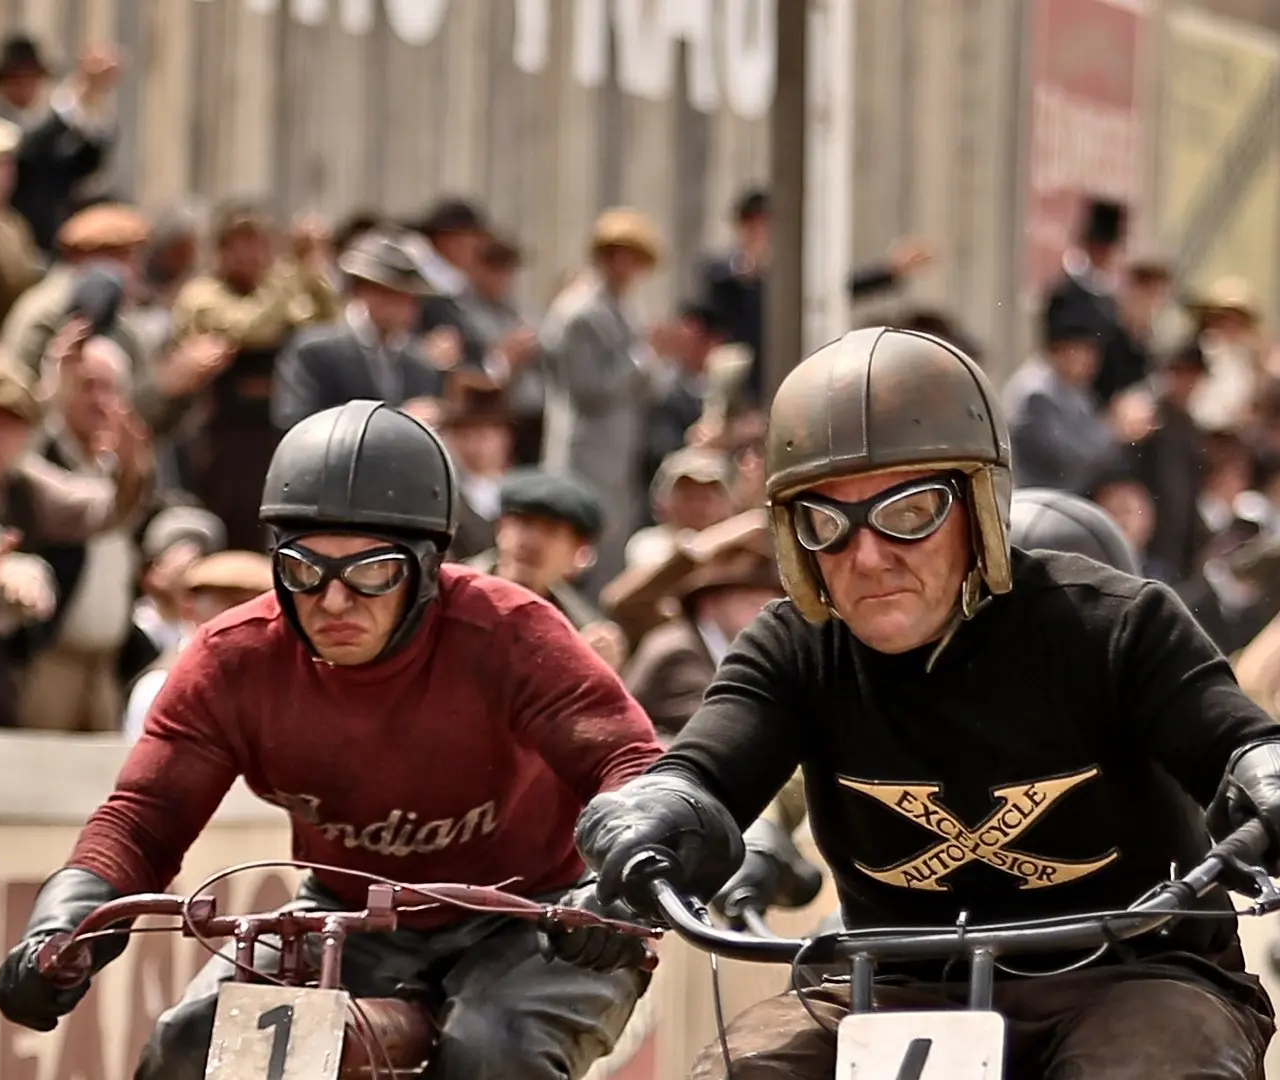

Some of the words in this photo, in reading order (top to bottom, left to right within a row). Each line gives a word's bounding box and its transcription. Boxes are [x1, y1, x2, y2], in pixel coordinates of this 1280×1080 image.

[894, 789, 1057, 884] EXCELSIOR
[900, 843, 966, 889] AUTO
[978, 783, 1047, 850] CYCLE
